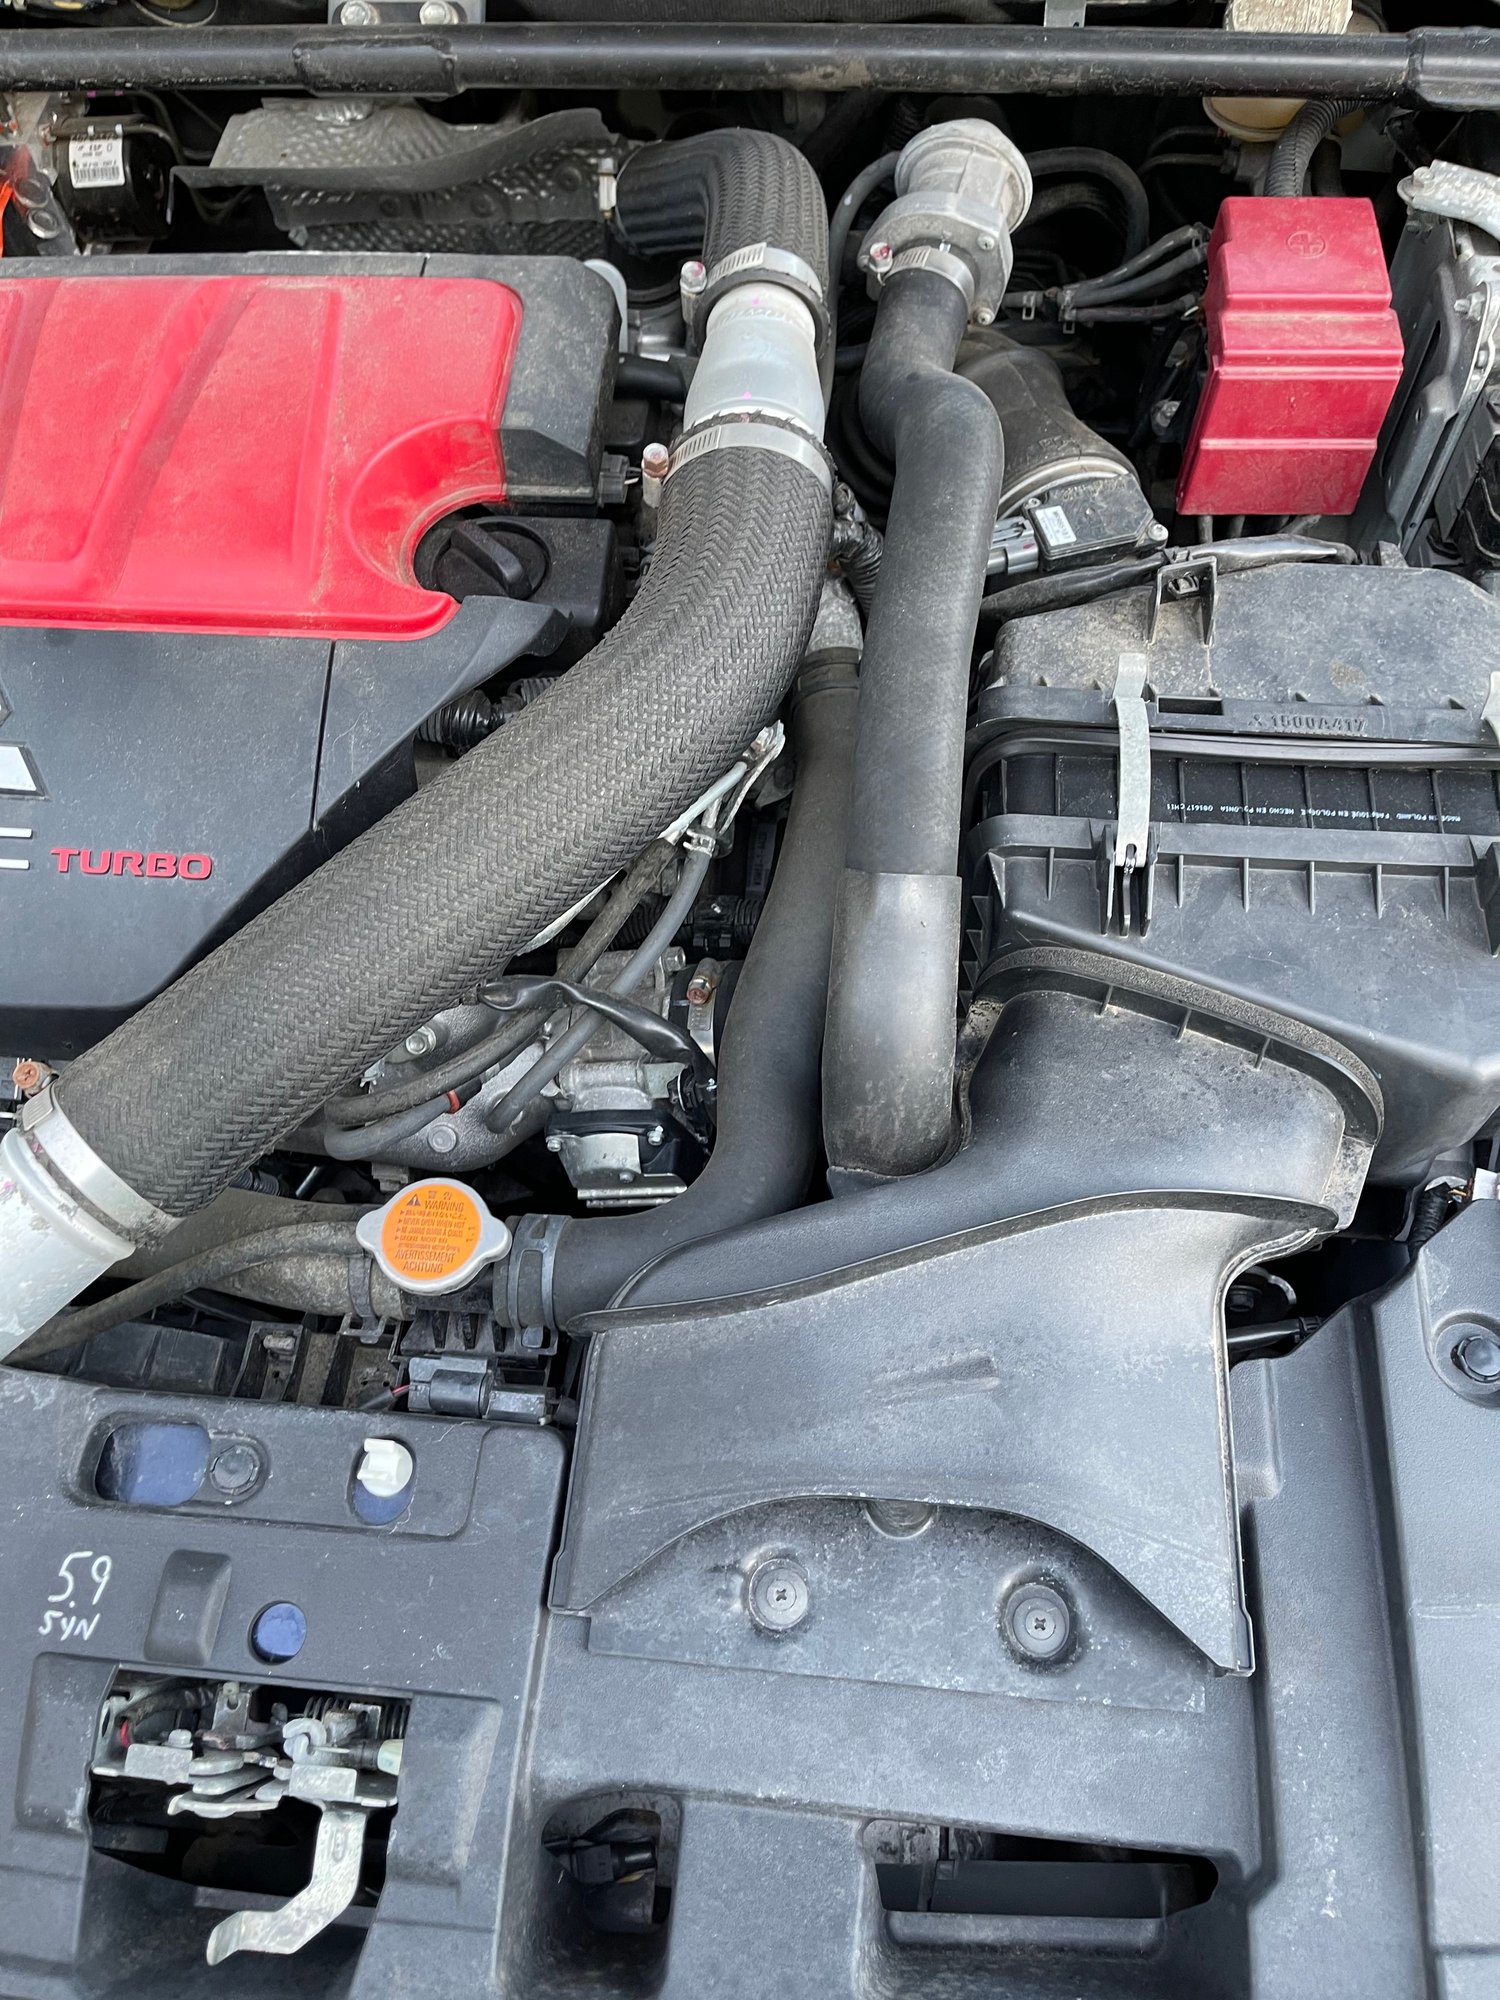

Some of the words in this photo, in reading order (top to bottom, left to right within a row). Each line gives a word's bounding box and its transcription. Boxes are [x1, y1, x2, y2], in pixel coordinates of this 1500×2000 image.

[50, 847, 213, 880] TURBO
[425, 1200, 464, 1212] WARNING
[420, 1218, 435, 1227] OPEN
[395, 1249, 456, 1263] AVERTISSEMENT
[403, 1261, 443, 1273] ACHTUNG
[48, 1551, 112, 1608] 5.9
